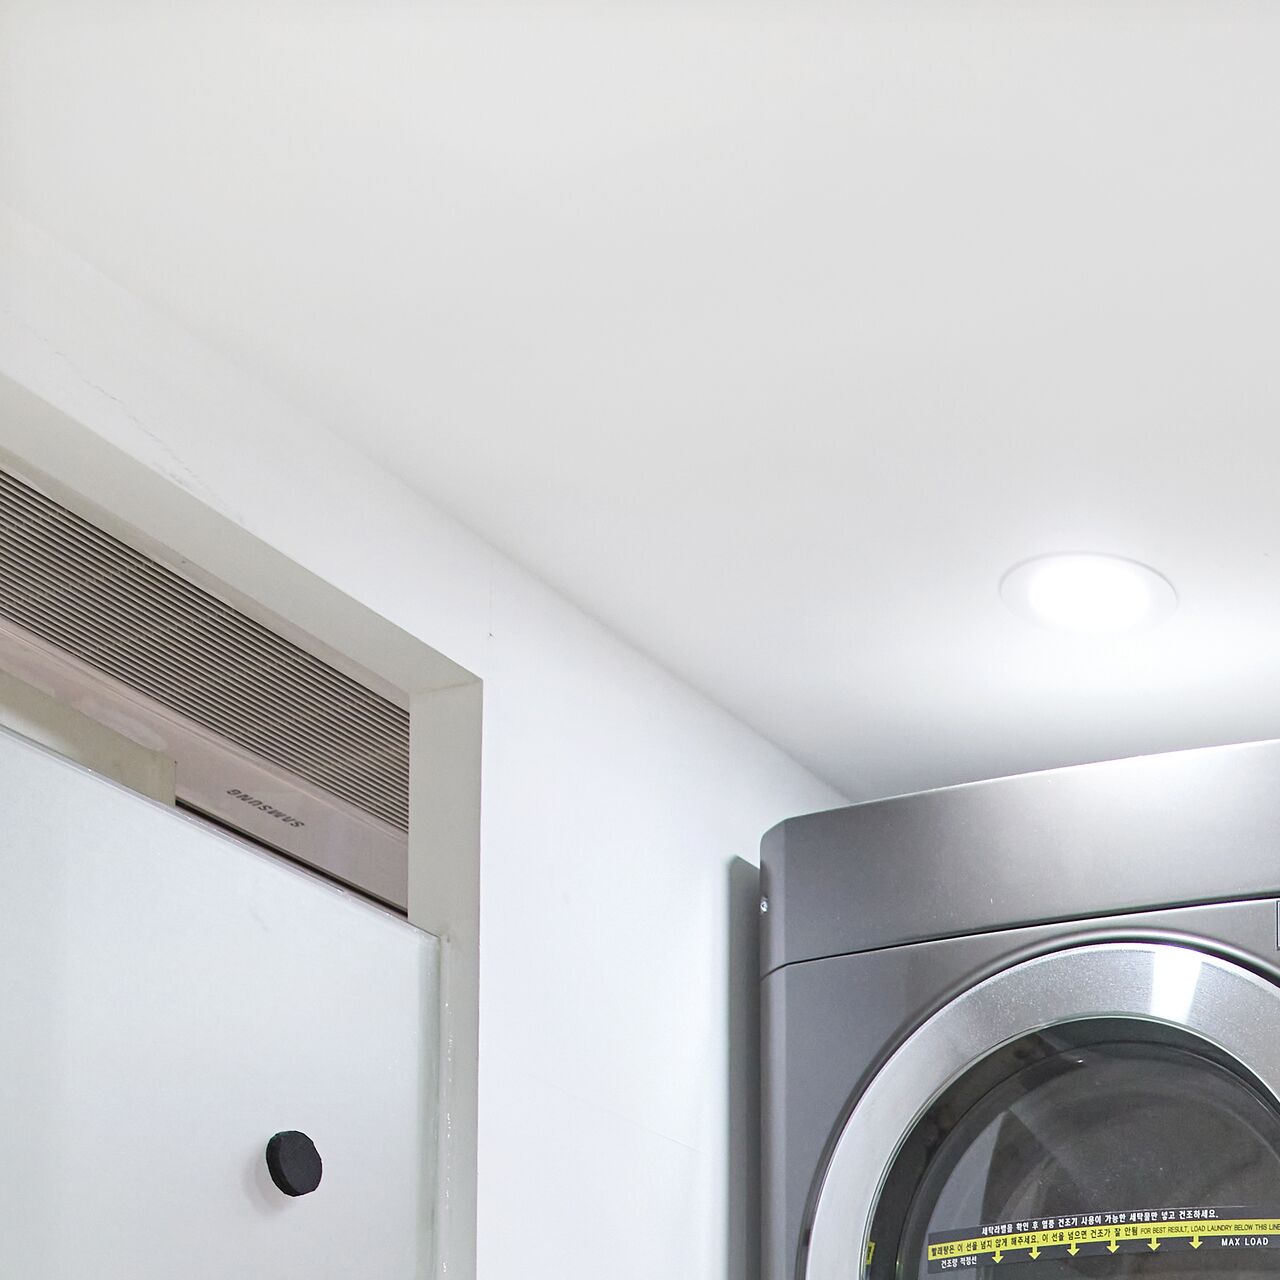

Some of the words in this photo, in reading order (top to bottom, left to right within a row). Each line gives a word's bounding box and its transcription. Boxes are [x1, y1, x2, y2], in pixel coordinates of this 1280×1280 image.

[227, 789, 305, 827] SAMSUNG
[1207, 1224, 1232, 1232] LAUNDRY
[1234, 1223, 1253, 1231] BELOW
[1222, 1238, 1240, 1246] MAX
